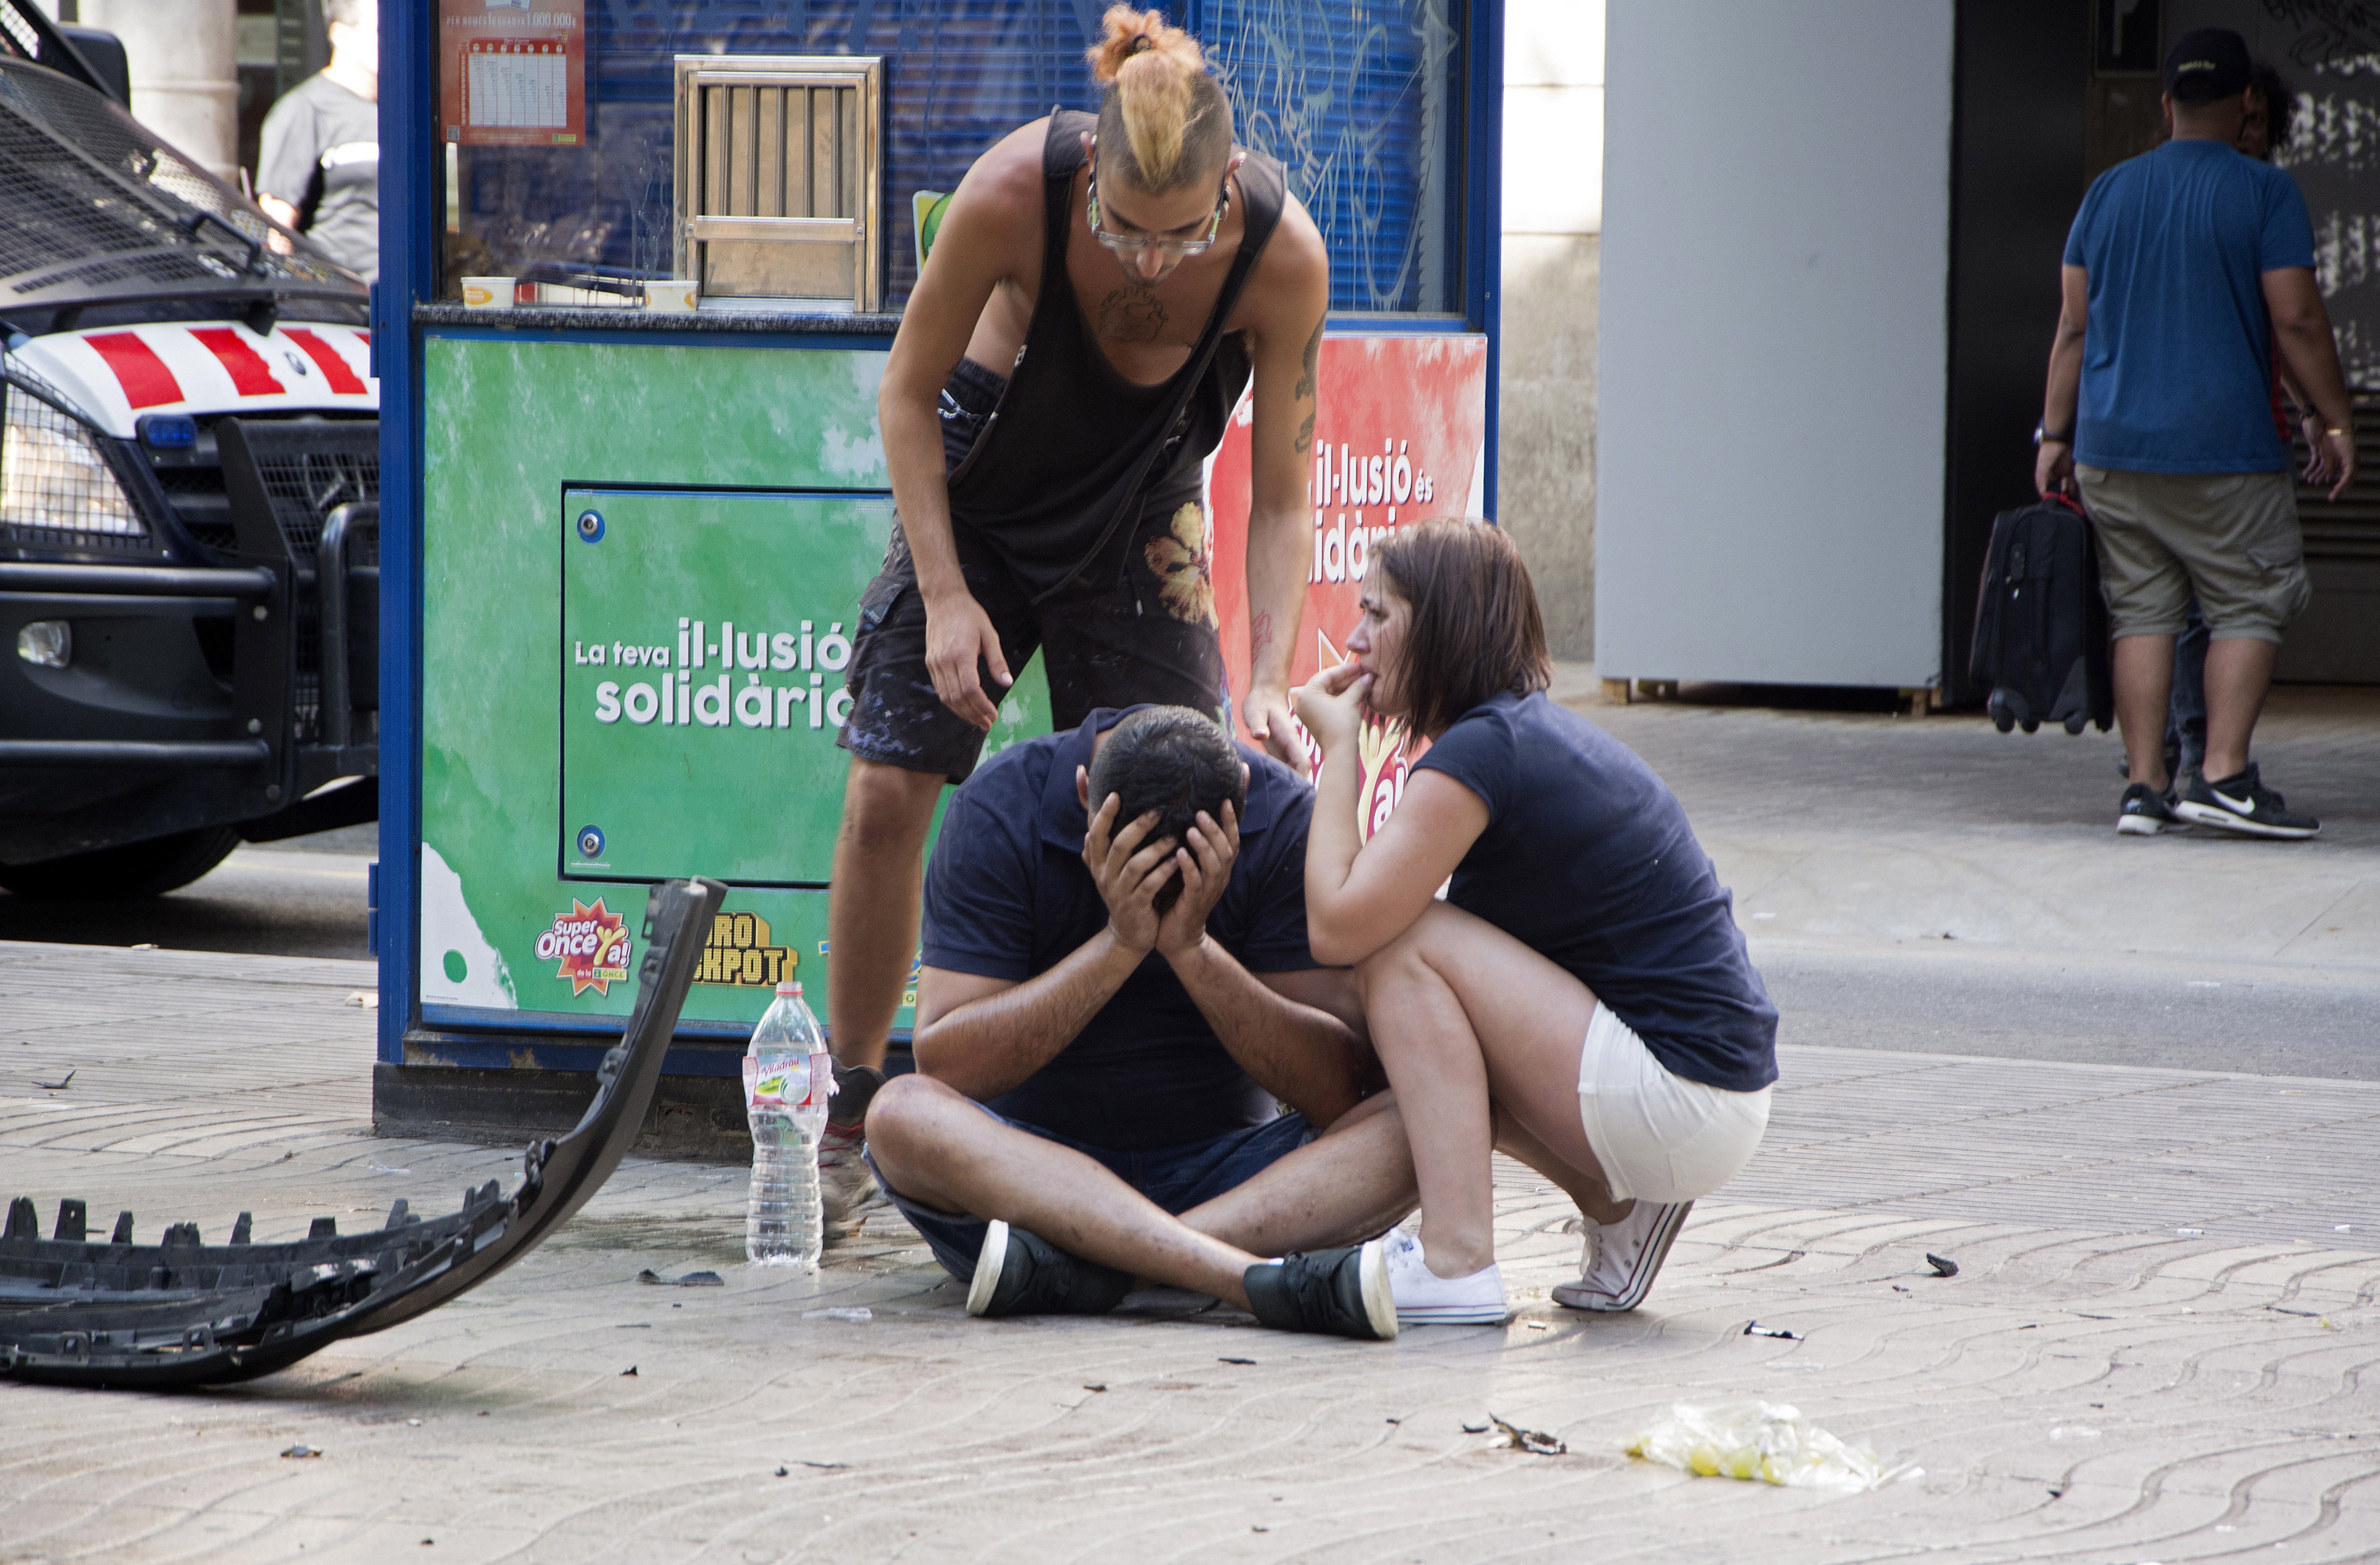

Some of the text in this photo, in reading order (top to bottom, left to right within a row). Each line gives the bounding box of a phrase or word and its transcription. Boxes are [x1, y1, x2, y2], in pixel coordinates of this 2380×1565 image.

[1415, 469, 1433, 503] és
[575, 641, 606, 666] La
[614, 641, 670, 667] teva
[762, 1058, 800, 1076] Viladrau
